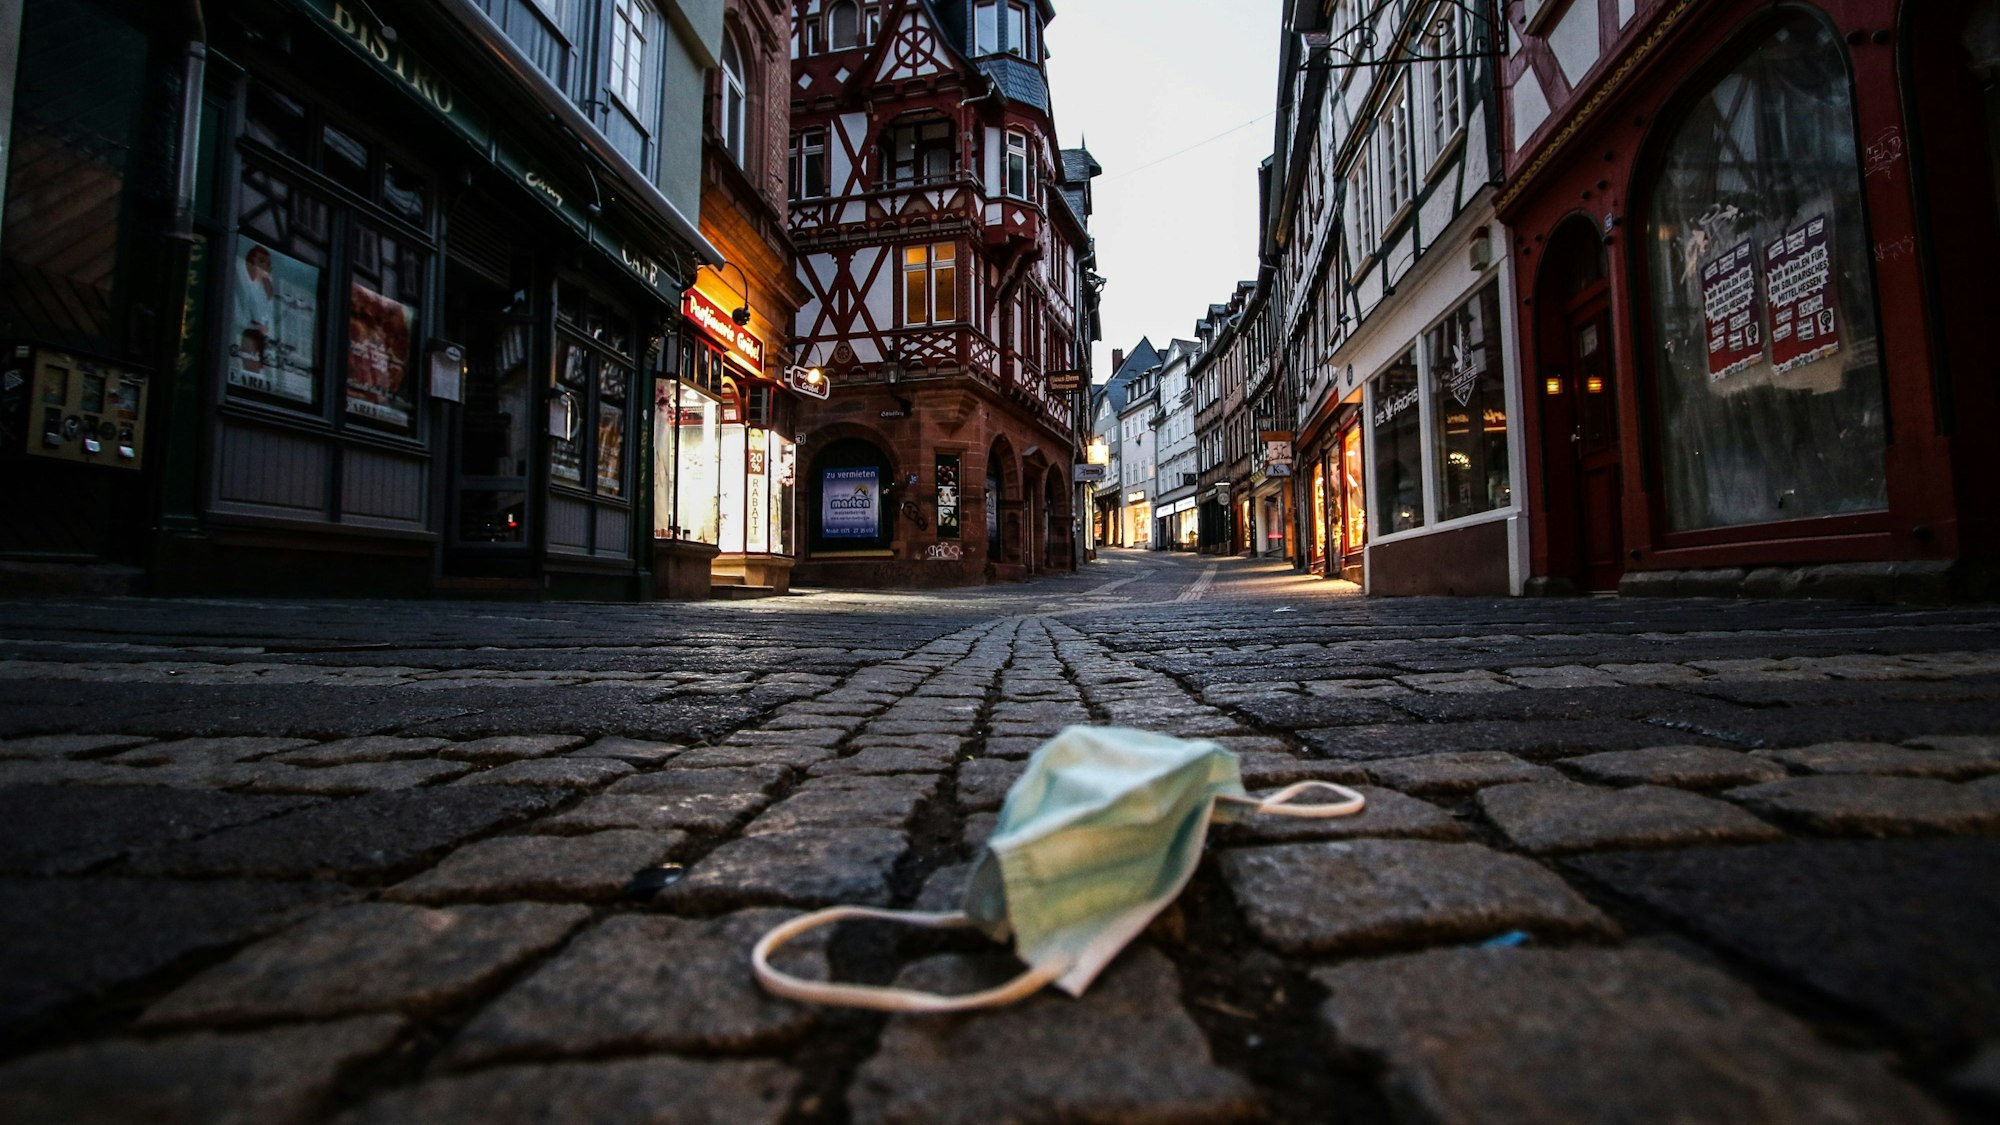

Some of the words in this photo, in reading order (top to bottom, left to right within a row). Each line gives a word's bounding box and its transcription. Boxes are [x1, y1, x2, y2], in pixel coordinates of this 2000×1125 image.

[333, 1, 453, 113] BISTRO
[1811, 247, 1825, 262] FÜR
[1771, 283, 1780, 296] EIN
[1781, 259, 1828, 290] SOLIDARISCHES
[1778, 274, 1823, 304] MITTELHESSEN
[1713, 294, 1749, 318] MITTELHESSEN
[750, 452, 763, 463] 20
[751, 463, 761, 472] %
[837, 470, 876, 478] vermieten
[751, 479, 759, 536] RABATT
[830, 496, 870, 509] marten
